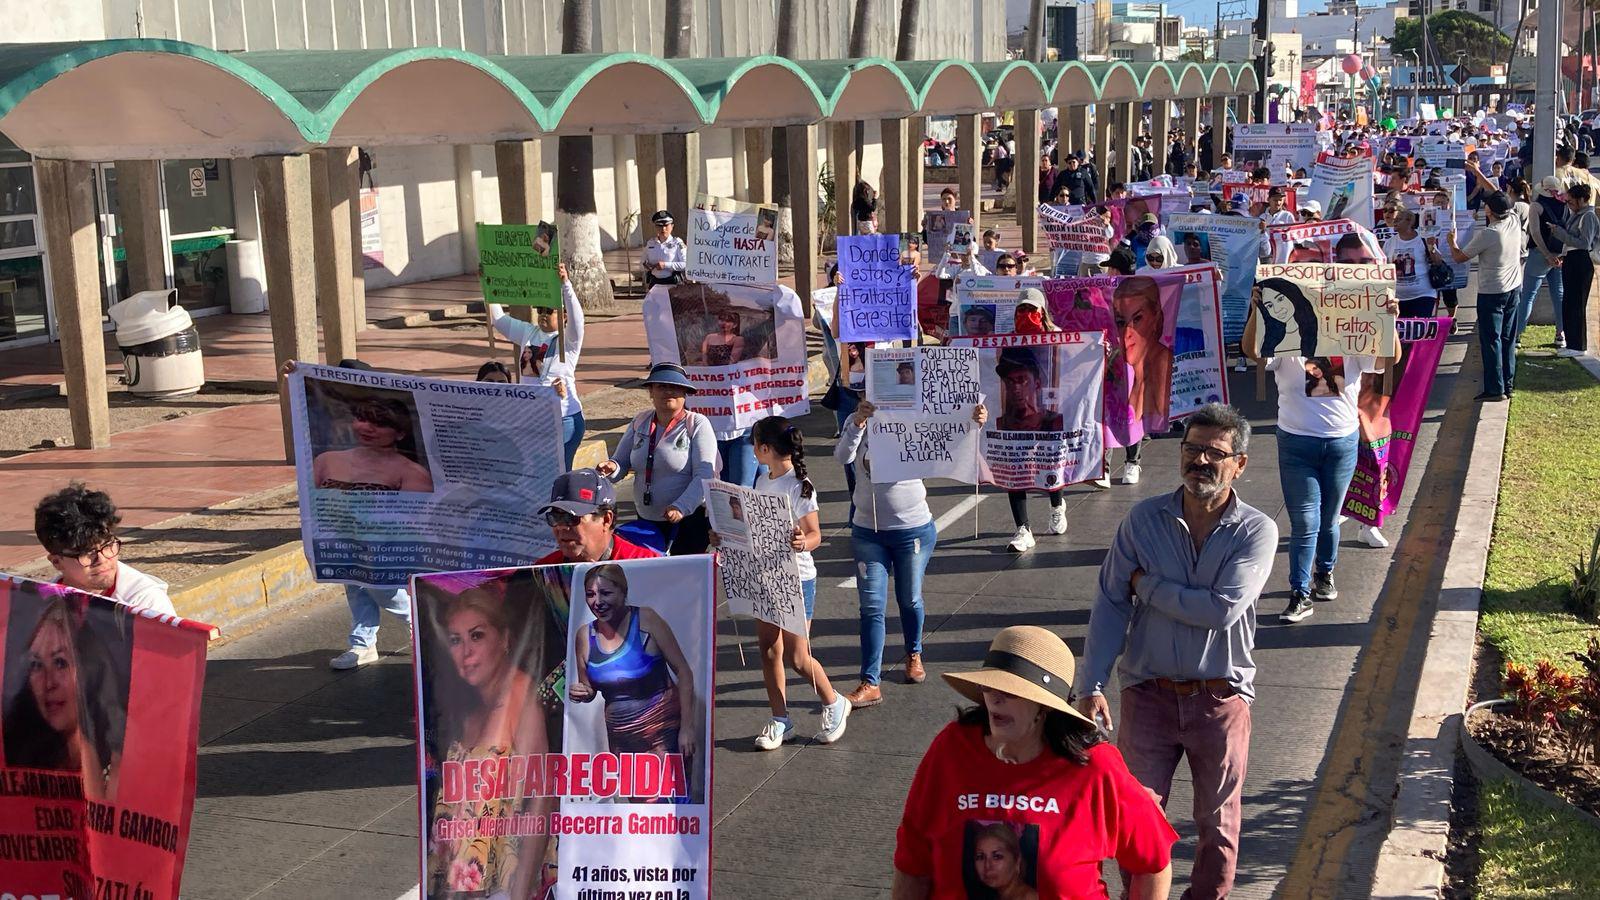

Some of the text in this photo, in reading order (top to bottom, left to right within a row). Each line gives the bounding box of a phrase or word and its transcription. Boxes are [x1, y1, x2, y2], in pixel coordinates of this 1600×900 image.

[694, 217, 711, 232] No
[742, 222, 755, 235] de
[1281, 222, 1355, 241] DESAPAREC
[694, 234, 766, 252] buscarte HASTA
[698, 251, 771, 269] ENCONTRARTE
[849, 242, 900, 264] Donde
[851, 264, 906, 287] estas?
[1258, 264, 1396, 282] #Desaparecida
[1309, 285, 1390, 311] Teresita
[844, 306, 918, 330] Teresita!
[973, 332, 1082, 348] DESAPARECIDO
[729, 371, 741, 380] TÚ
[744, 365, 805, 378] TERESITA!!!
[920, 360, 970, 371] QUE LOS
[312, 366, 536, 400] TERESITA DE JESÚS GUTIERREZ RÍOS
[921, 370, 972, 382] ZAPATOS
[689, 379, 805, 397] EREMOS DE REGRESO
[922, 381, 980, 393] DE MI HIJO
[690, 394, 804, 417] AMILIA TE ESPERA
[921, 391, 937, 404] ME
[922, 404, 931, 414] A
[896, 432, 953, 442] TU MADRE
[914, 422, 971, 435] ESCUCHA)
[905, 441, 946, 452] ESTA EN
[900, 451, 953, 462] LA LUCHA
[320, 551, 349, 559] llama
[422, 555, 433, 563] Tu
[388, 572, 408, 580] 842
[0, 770, 86, 801] LEJANDRIN
[441, 752, 688, 804] DESAPARECIDA
[957, 793, 1060, 814] SE BUSCA
[119, 809, 179, 854] GAMBOA
[479, 811, 546, 839] Alejandrina
[551, 813, 624, 836] Becerra
[628, 813, 701, 836] Gamboa
[572, 865, 697, 886] 41 años, vista por
[577, 887, 626, 900] última
